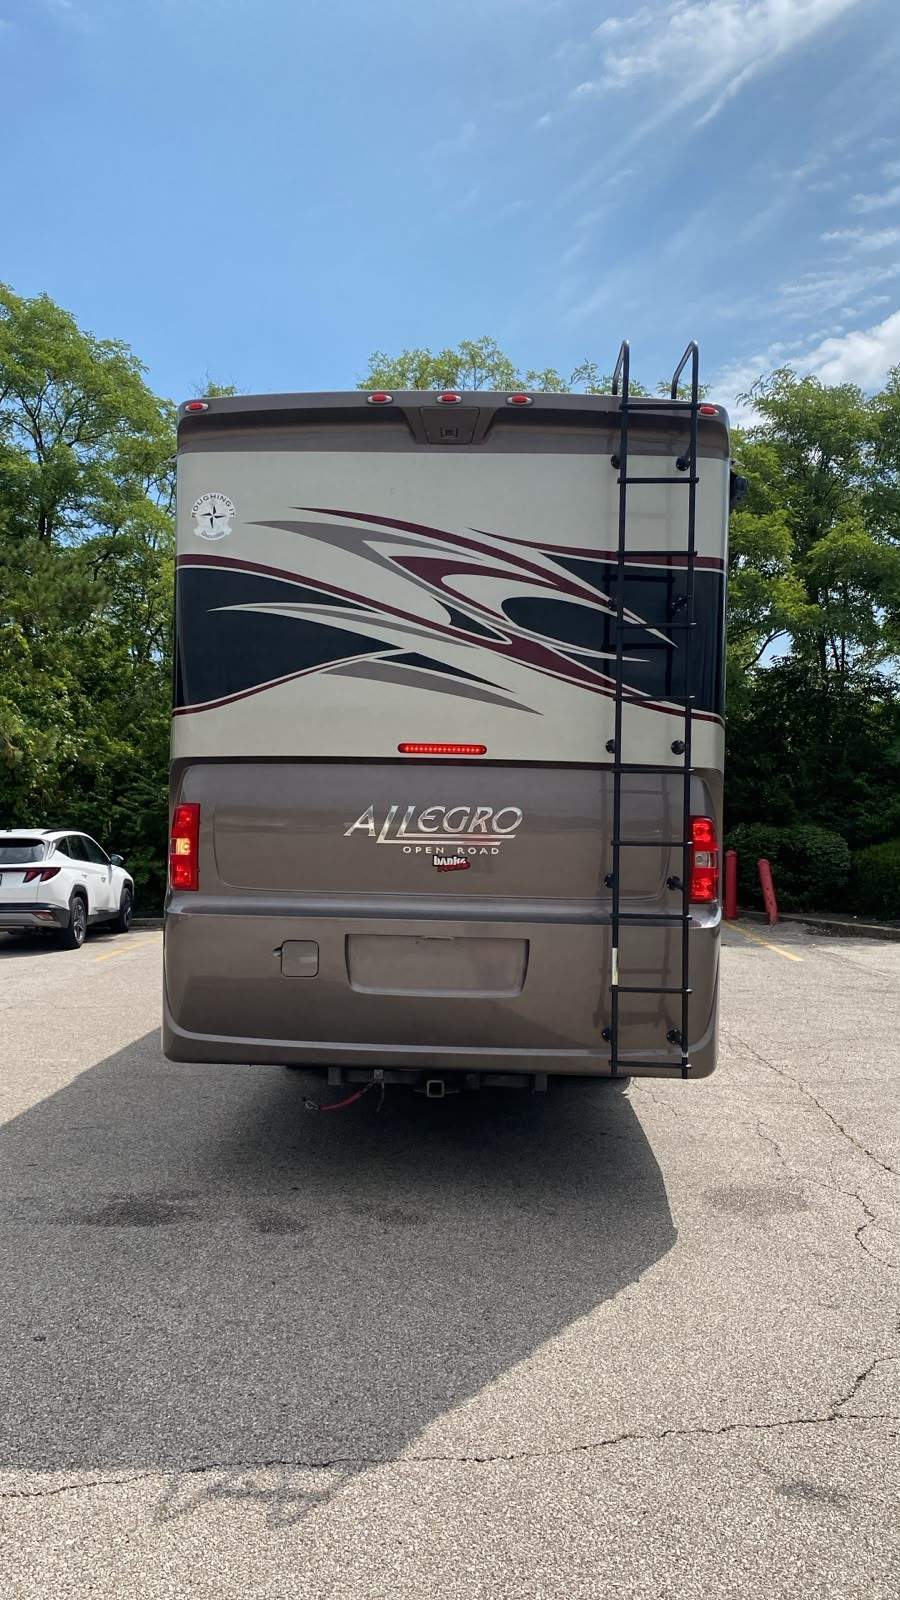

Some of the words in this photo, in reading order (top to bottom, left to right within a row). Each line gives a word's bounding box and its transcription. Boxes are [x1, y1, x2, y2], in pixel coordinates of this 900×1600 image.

[191, 494, 232, 518] ROUGHING
[343, 804, 523, 845] ALLEGRO
[402, 846, 444, 854] OPEN
[457, 846, 500, 855] ROAD
